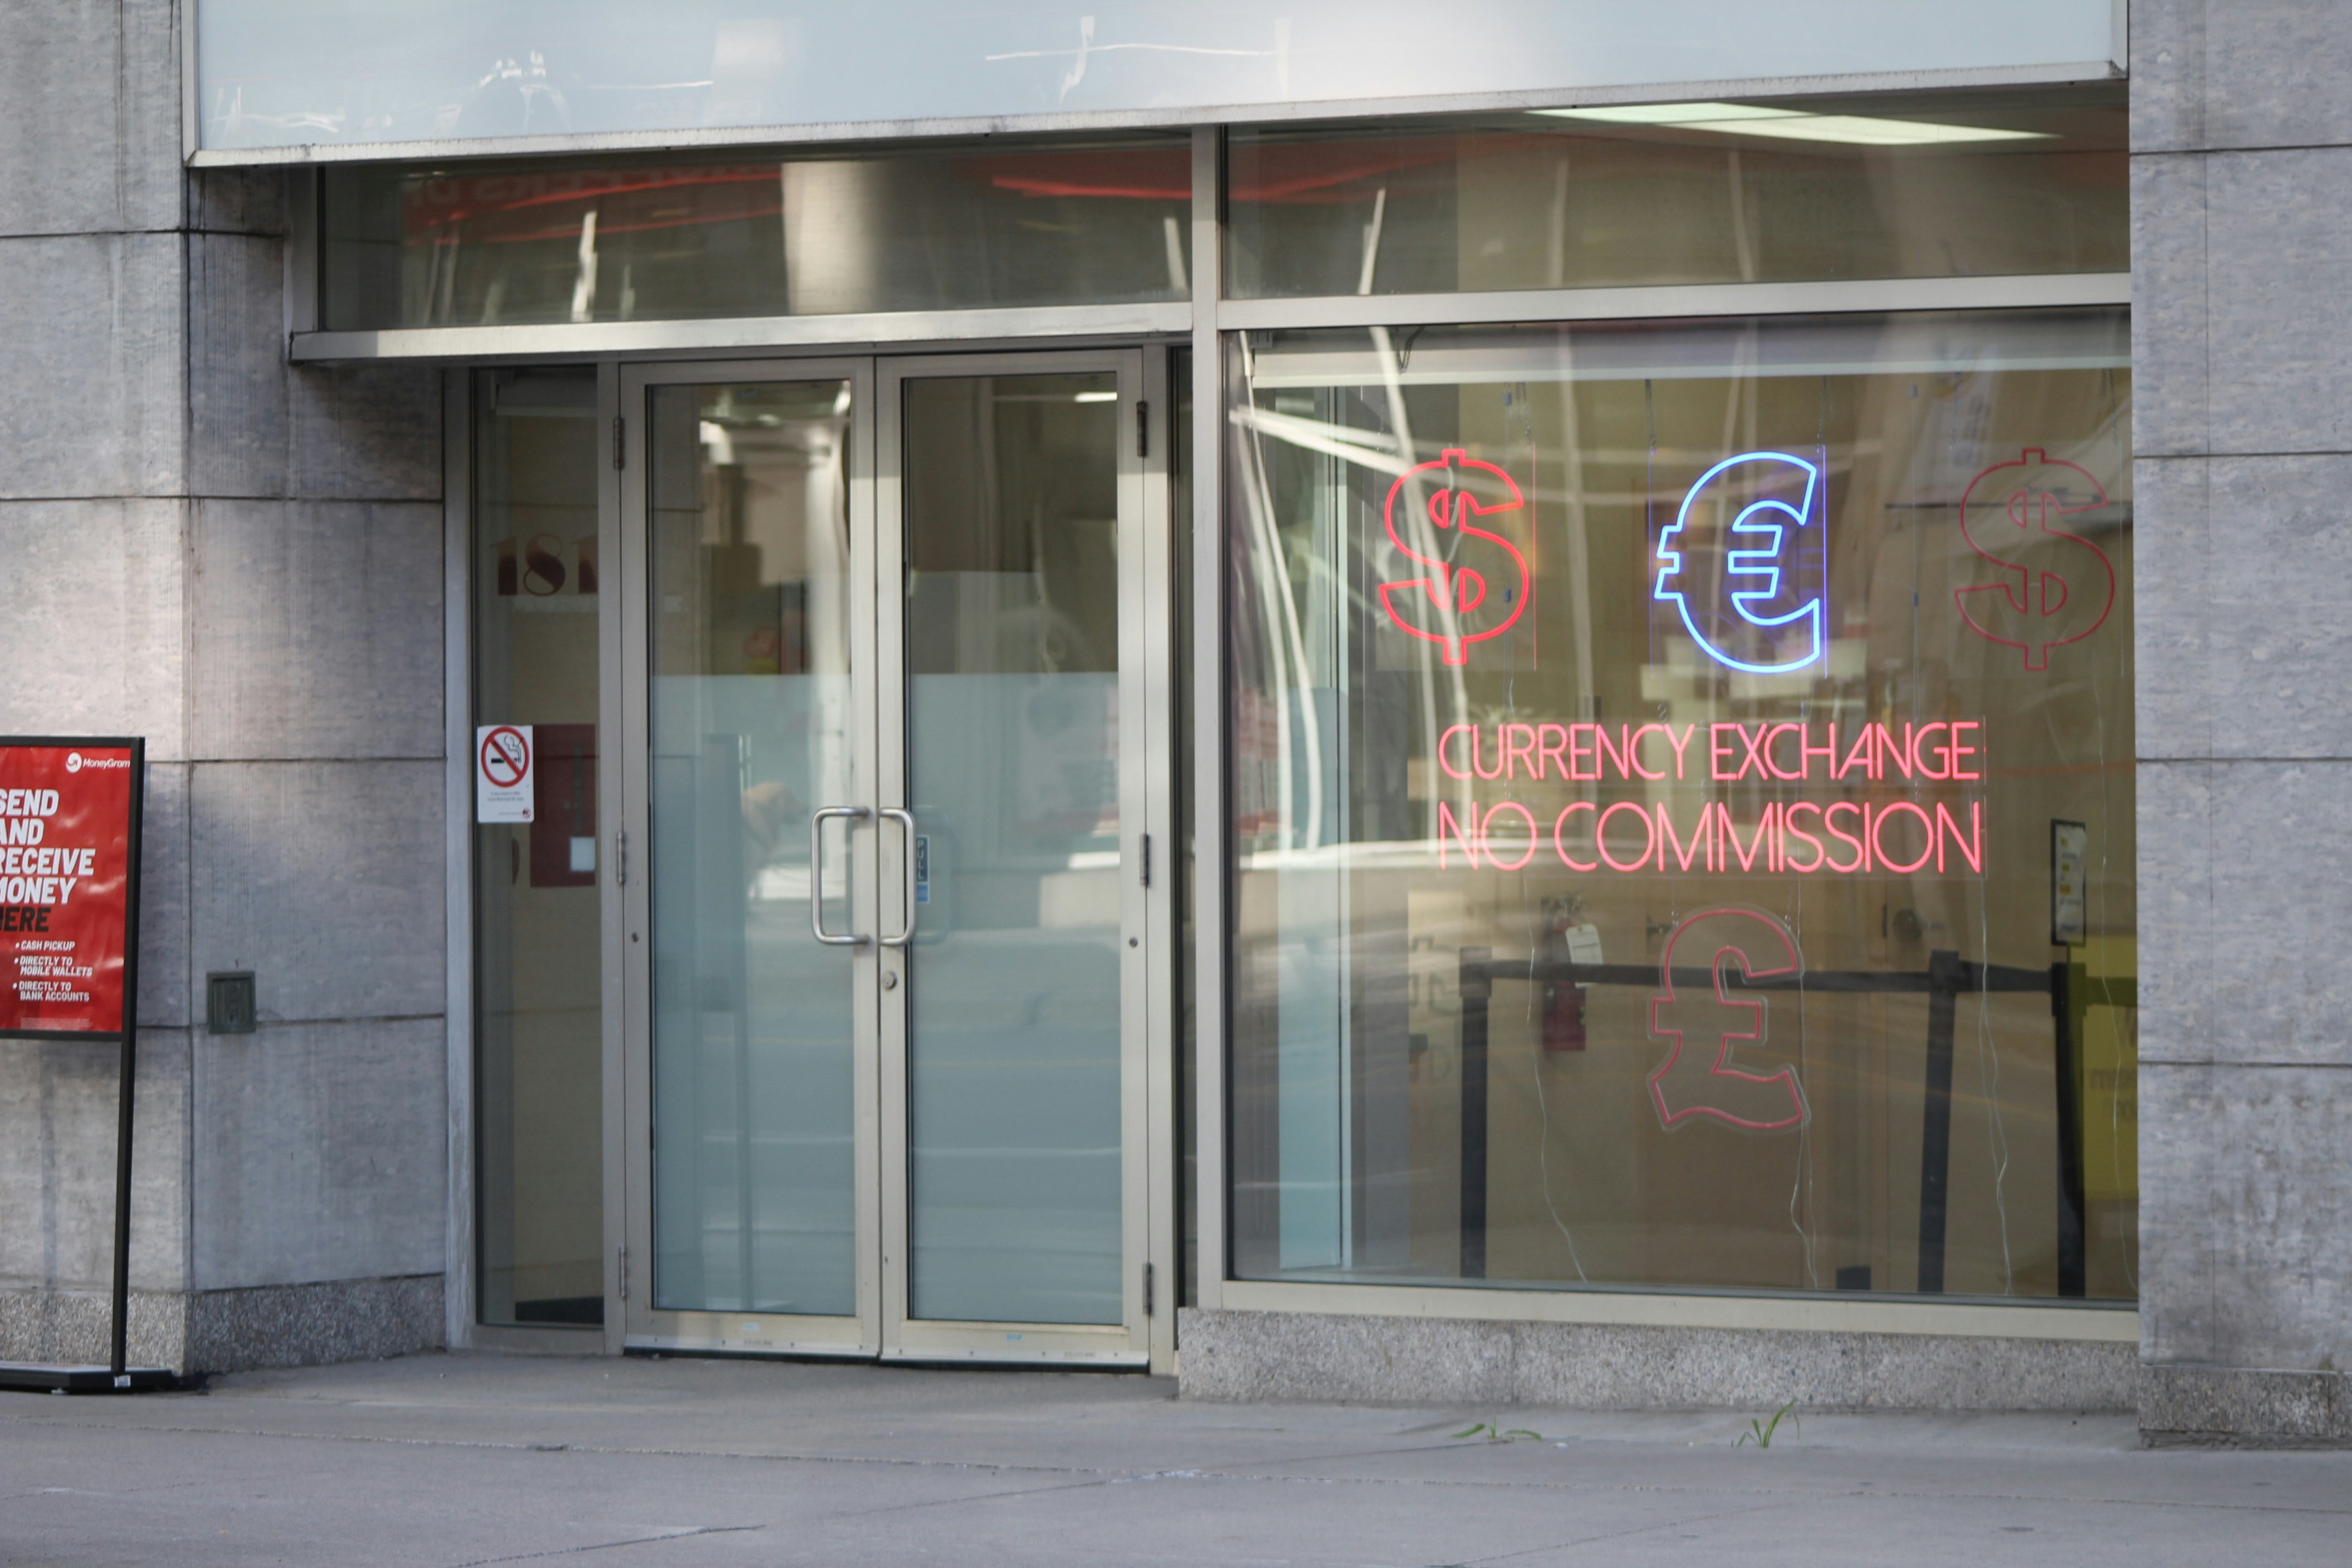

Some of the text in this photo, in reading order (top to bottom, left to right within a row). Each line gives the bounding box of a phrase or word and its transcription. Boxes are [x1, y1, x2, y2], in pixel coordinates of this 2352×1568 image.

[489, 533, 598, 597] 181
[1438, 721, 1980, 781] CURRENCY EXCHANGE
[82, 757, 131, 770] MoneyGram
[1438, 800, 1981, 873] NO COMMISSION
[917, 839, 925, 881] PULL
[21, 940, 76, 951] CASH PICKUP
[20, 955, 73, 966] DIRECTLY TO
[20, 965, 93, 977] MOBILE WALLETS
[19, 980, 71, 992] DIRECTLY TO
[20, 991, 90, 1002] BANK ACCOUNTS
